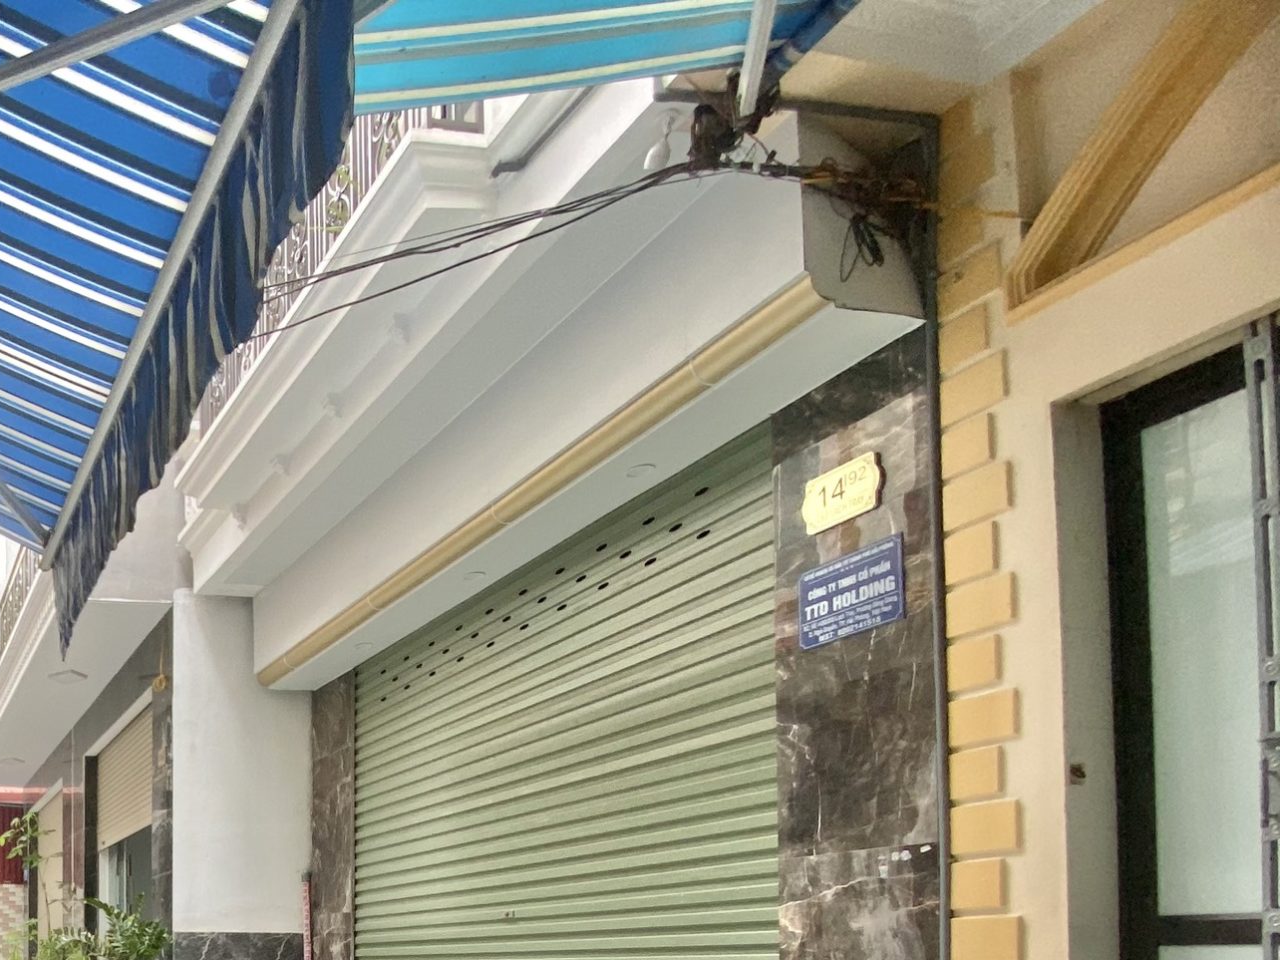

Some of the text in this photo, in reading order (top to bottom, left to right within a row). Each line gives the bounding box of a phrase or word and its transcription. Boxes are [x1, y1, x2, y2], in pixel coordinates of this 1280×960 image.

[819, 477, 845, 507] 14
[828, 582, 836, 593] TY
[833, 575, 896, 612] HOLDING
